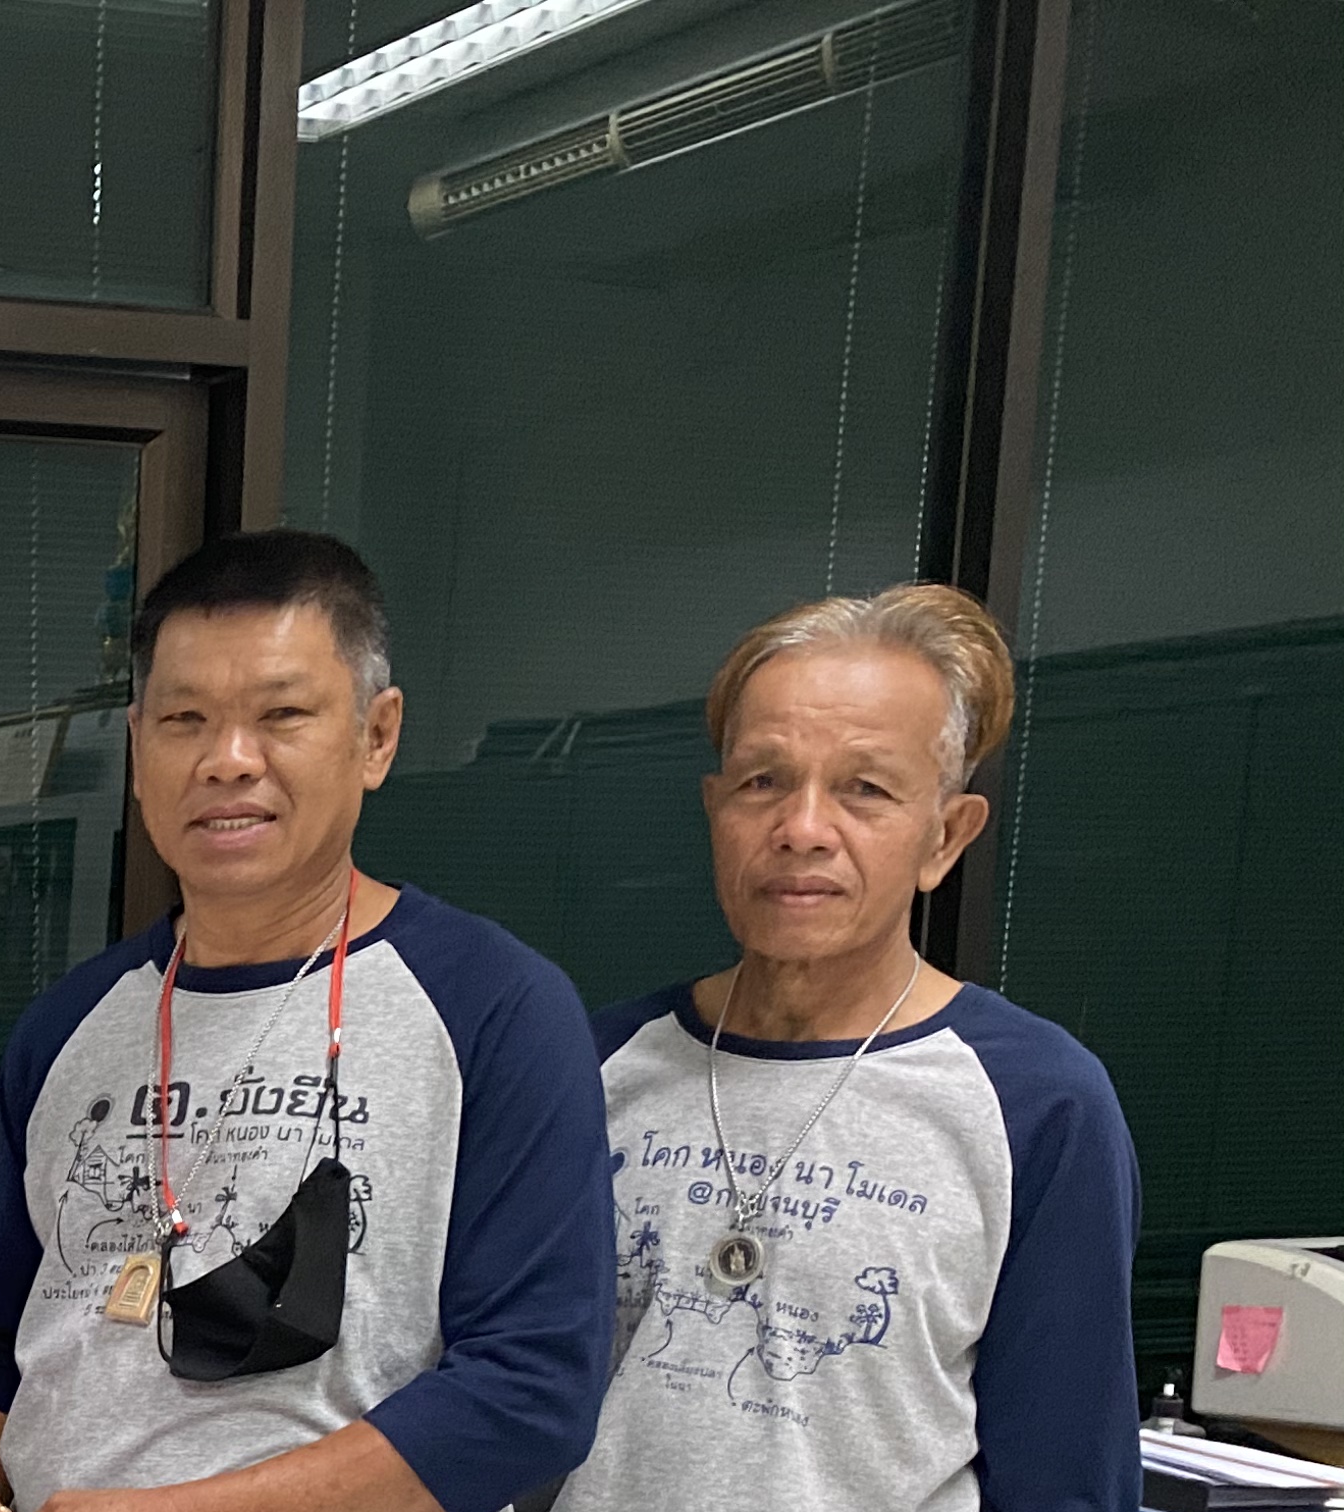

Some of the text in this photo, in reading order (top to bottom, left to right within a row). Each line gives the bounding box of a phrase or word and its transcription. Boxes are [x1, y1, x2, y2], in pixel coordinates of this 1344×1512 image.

[227, 1124, 270, 1143] หนอง
[277, 1125, 303, 1143] นา
[641, 1130, 691, 1168] โคก
[795, 1160, 834, 1190] นา
[845, 1160, 928, 1216] โมเดล
[776, 1300, 819, 1323] หนอง
